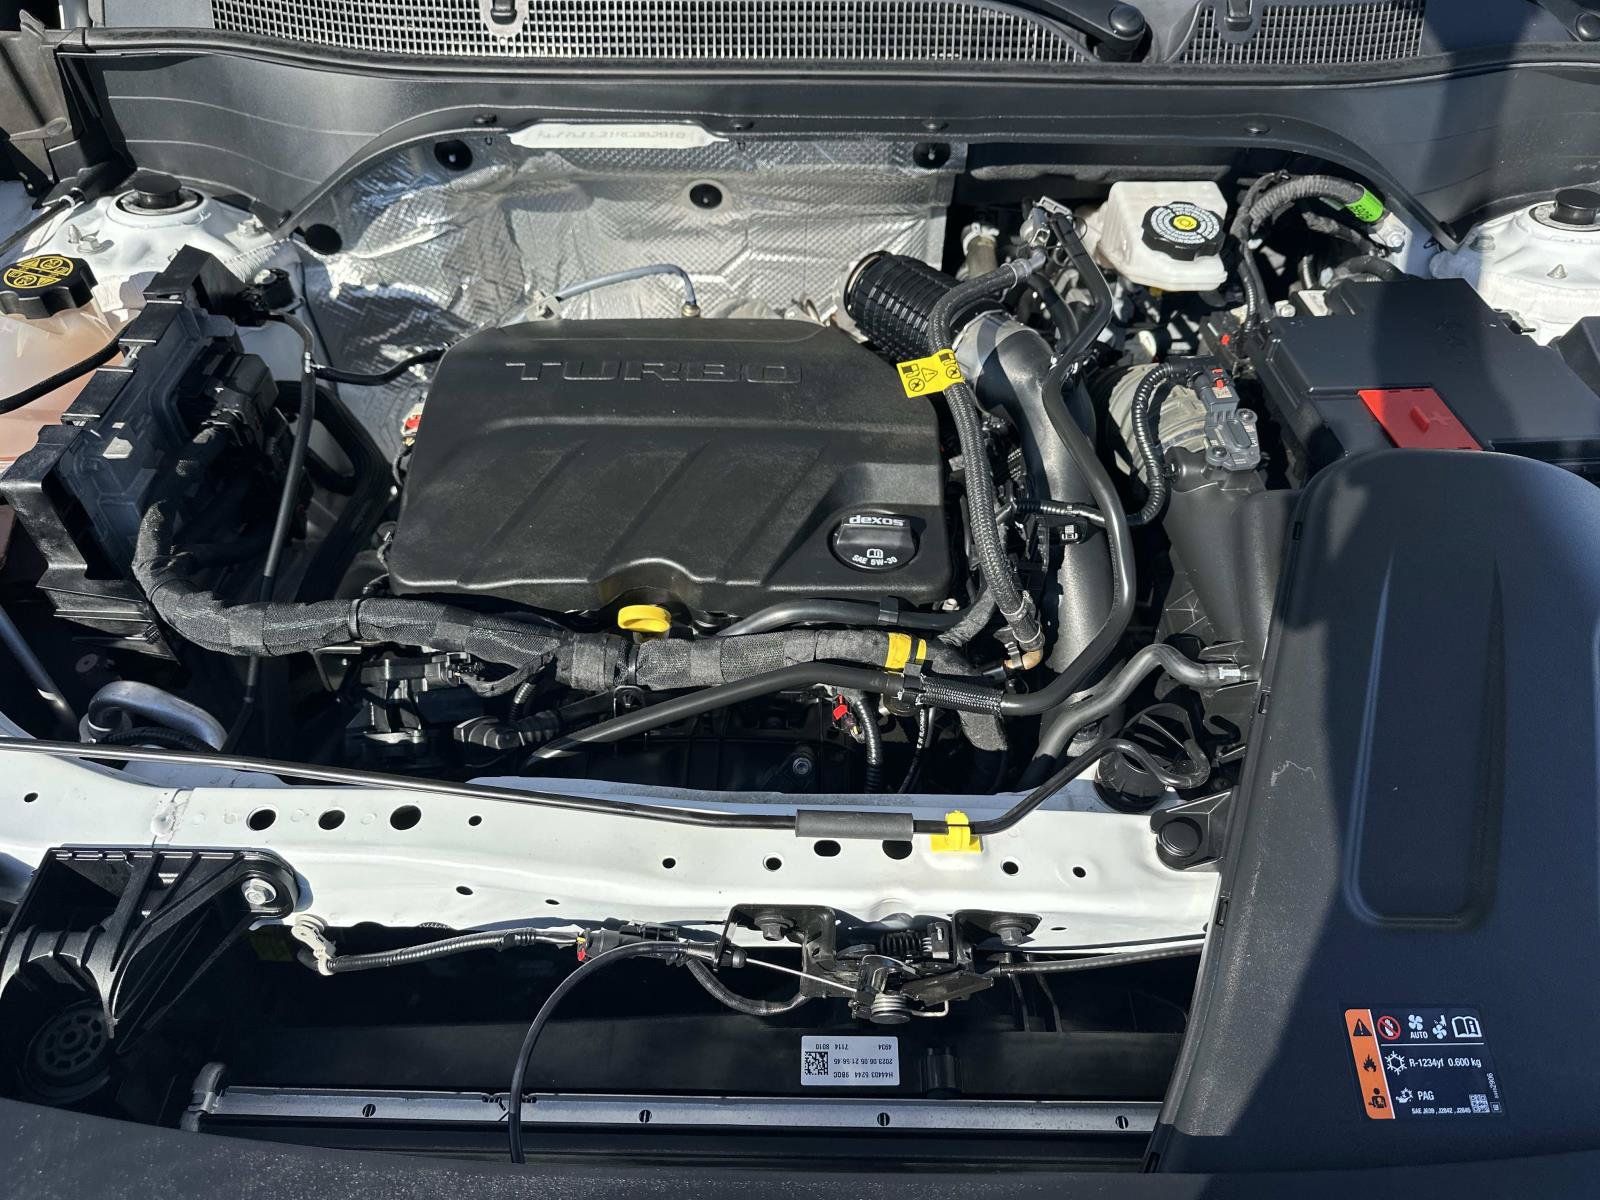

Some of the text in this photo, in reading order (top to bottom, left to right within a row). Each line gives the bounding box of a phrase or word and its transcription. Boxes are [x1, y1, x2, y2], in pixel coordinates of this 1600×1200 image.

[505, 361, 802, 383] TURBO
[849, 514, 905, 526] dexos
[852, 554, 898, 566] SAE 5W-30
[1410, 1031, 1428, 1039] AUTO
[1408, 1057, 1482, 1068] R-1234yf 0.600 kg
[1417, 1090, 1434, 1101] PAG
